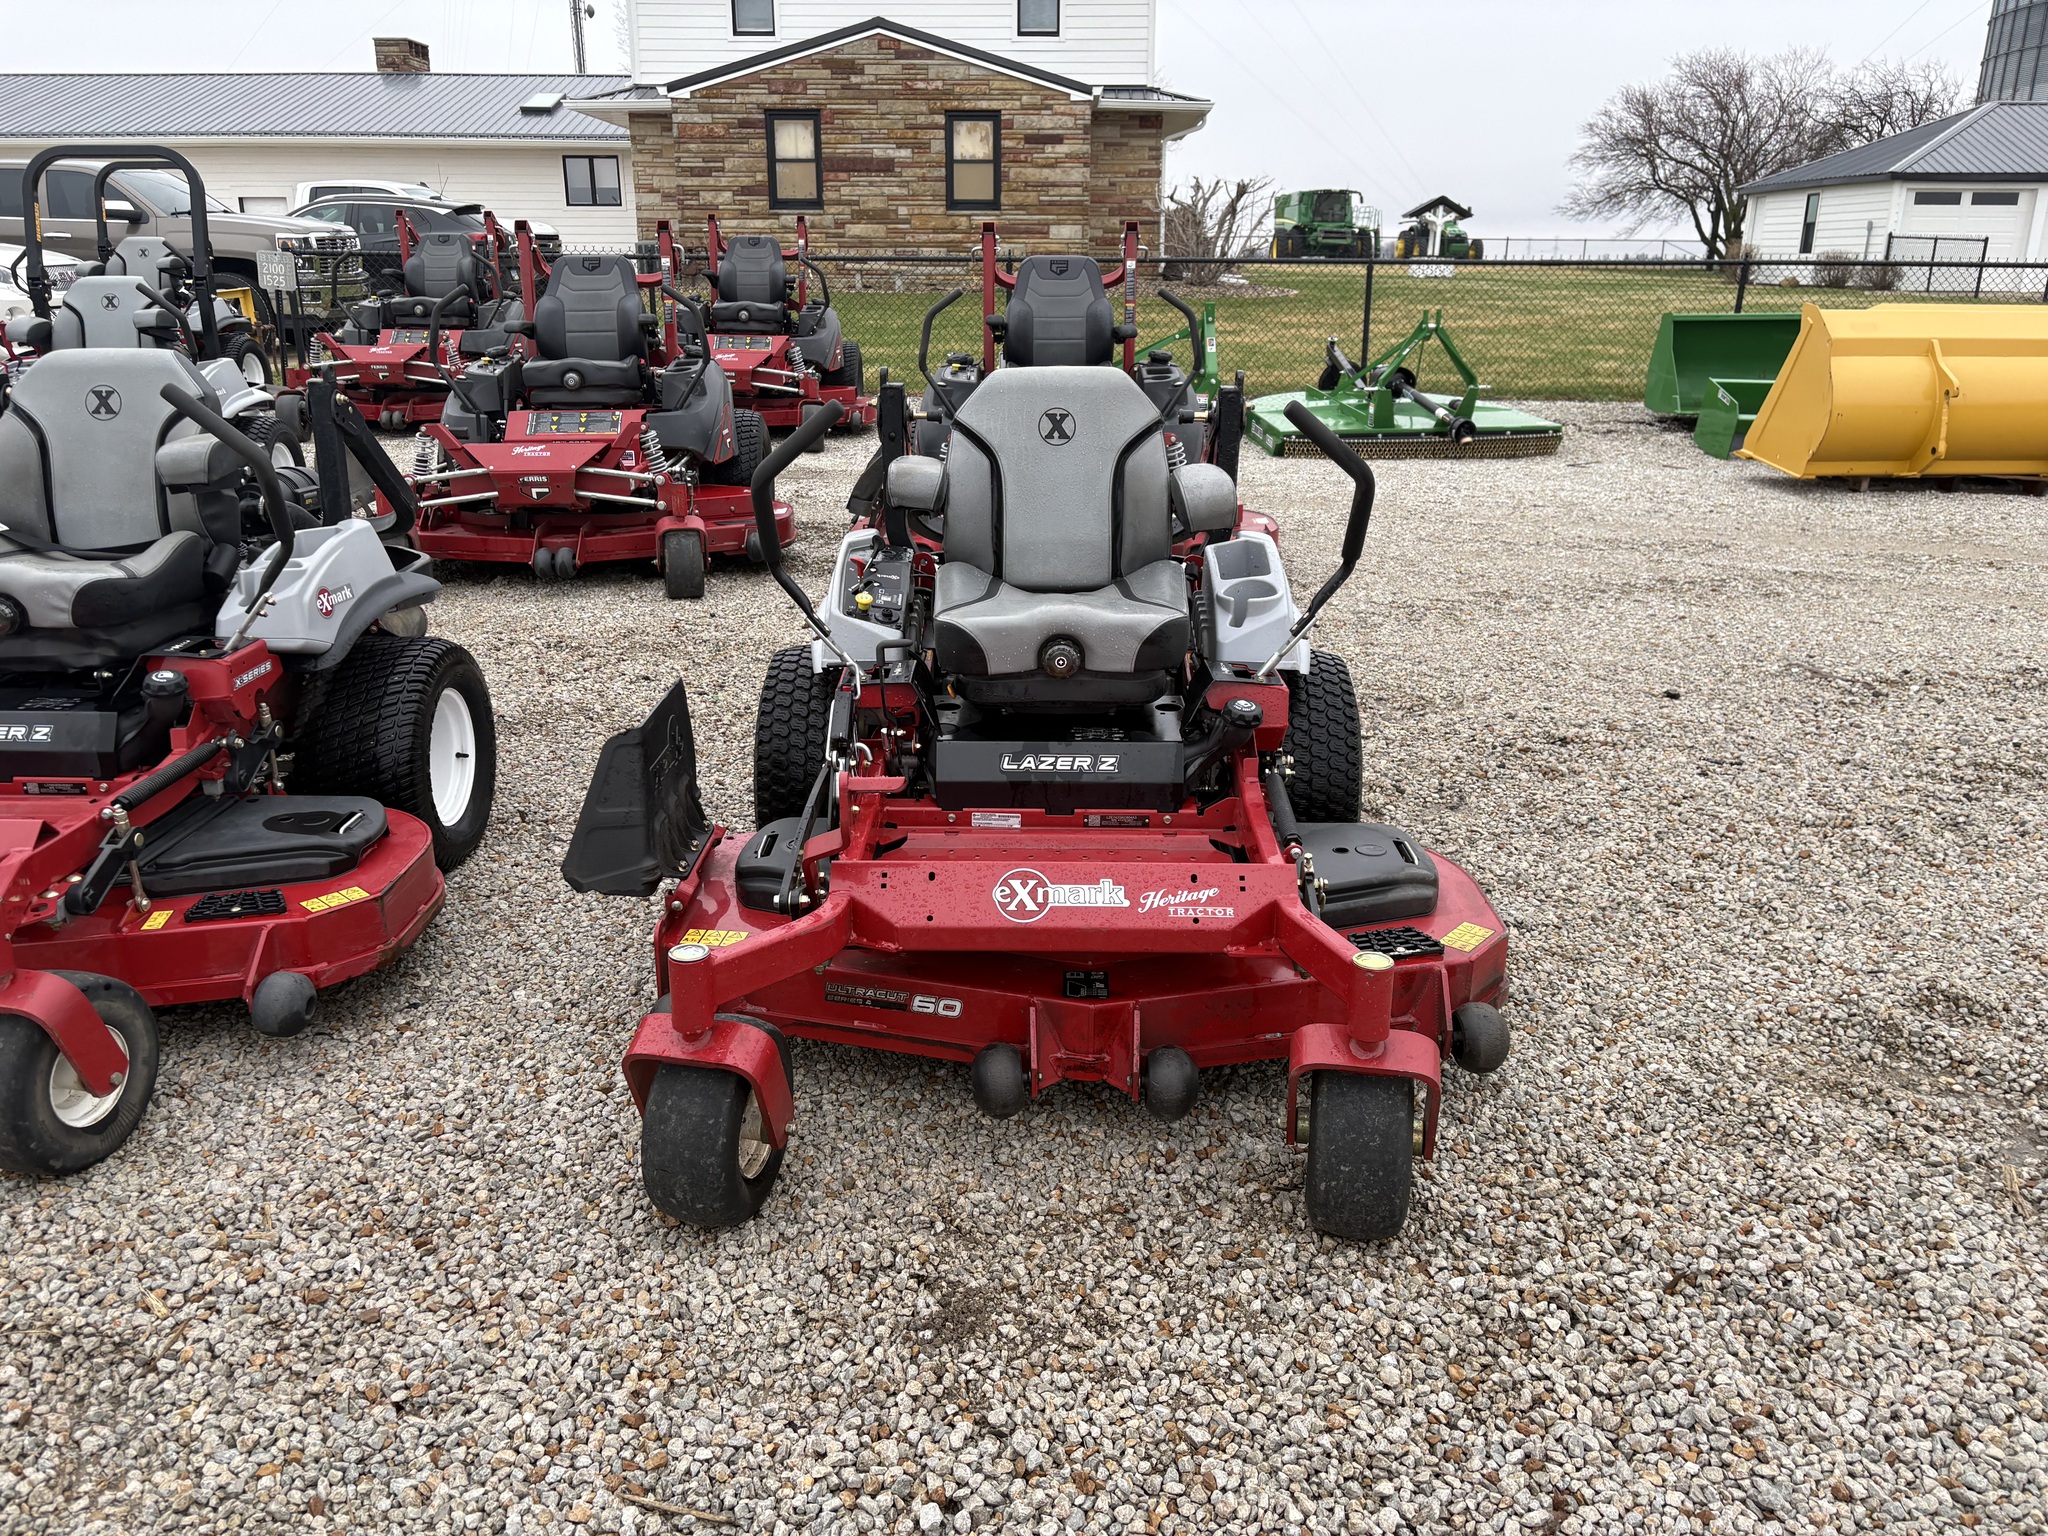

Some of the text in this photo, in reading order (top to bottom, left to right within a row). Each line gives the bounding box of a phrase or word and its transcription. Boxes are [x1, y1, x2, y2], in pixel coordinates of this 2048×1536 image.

[262, 262, 285, 275] 2100
[263, 274, 286, 287] 1525
[91, 390, 116, 415] X
[1044, 412, 1071, 440] X
[316, 584, 353, 614] eXmark
[29, 725, 54, 742] Z
[1001, 754, 1120, 772] LAZER Z
[993, 876, 1128, 914] eXmark
[1137, 887, 1220, 914] Heritage
[1168, 907, 1235, 917] TRACTOR
[826, 982, 963, 1018] ULTRACUT 60
[827, 995, 863, 1005] SERIES
